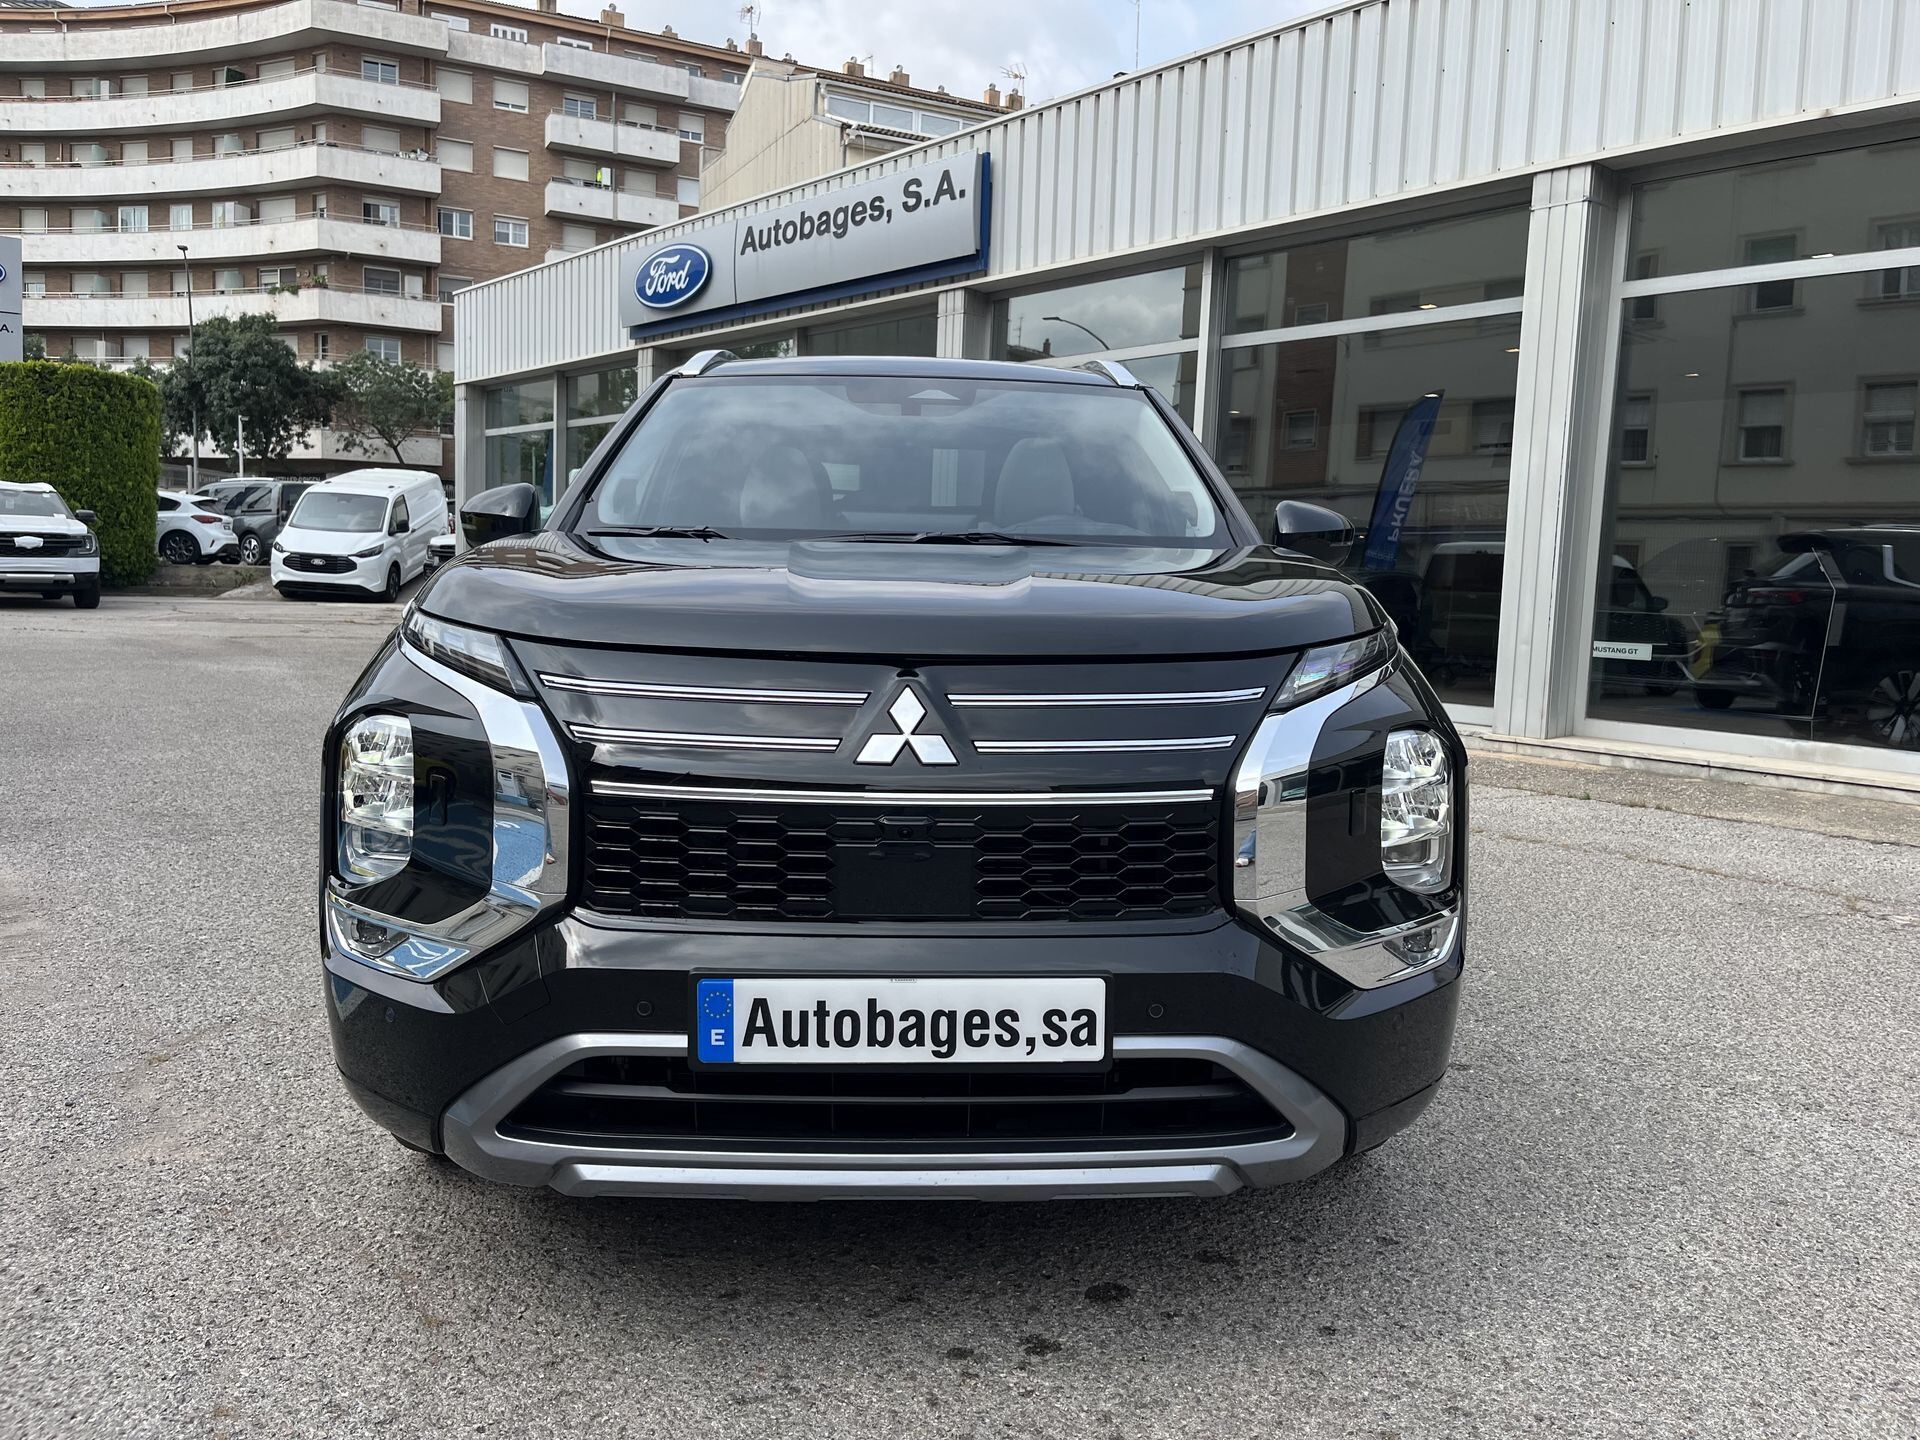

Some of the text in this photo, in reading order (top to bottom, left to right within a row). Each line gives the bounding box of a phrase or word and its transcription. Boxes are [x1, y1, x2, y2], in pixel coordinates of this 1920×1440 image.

[740, 168, 967, 256] Autobages, S.A.
[645, 254, 692, 297] Ford
[710, 997, 1098, 1060] E Autobages,sa
